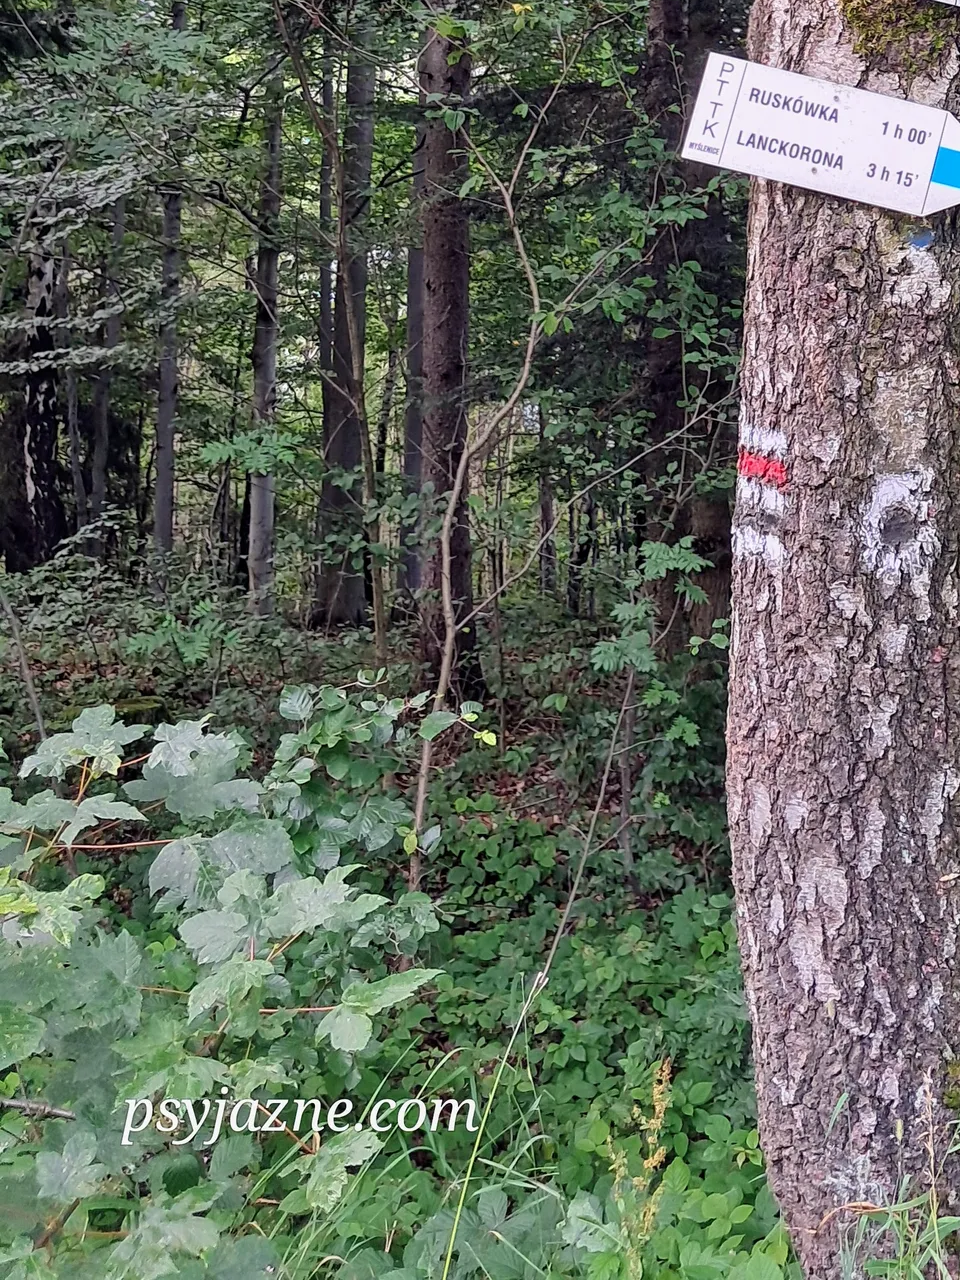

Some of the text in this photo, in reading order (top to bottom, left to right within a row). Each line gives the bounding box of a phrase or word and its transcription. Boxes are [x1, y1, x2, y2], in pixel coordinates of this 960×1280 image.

[749, 88, 839, 123] RUSKÓWKA
[882, 121, 889, 136] 1
[893, 123, 903, 139] h
[737, 130, 844, 171] LANCKORONA
[867, 163, 877, 179] 3
[880, 166, 890, 182] h
